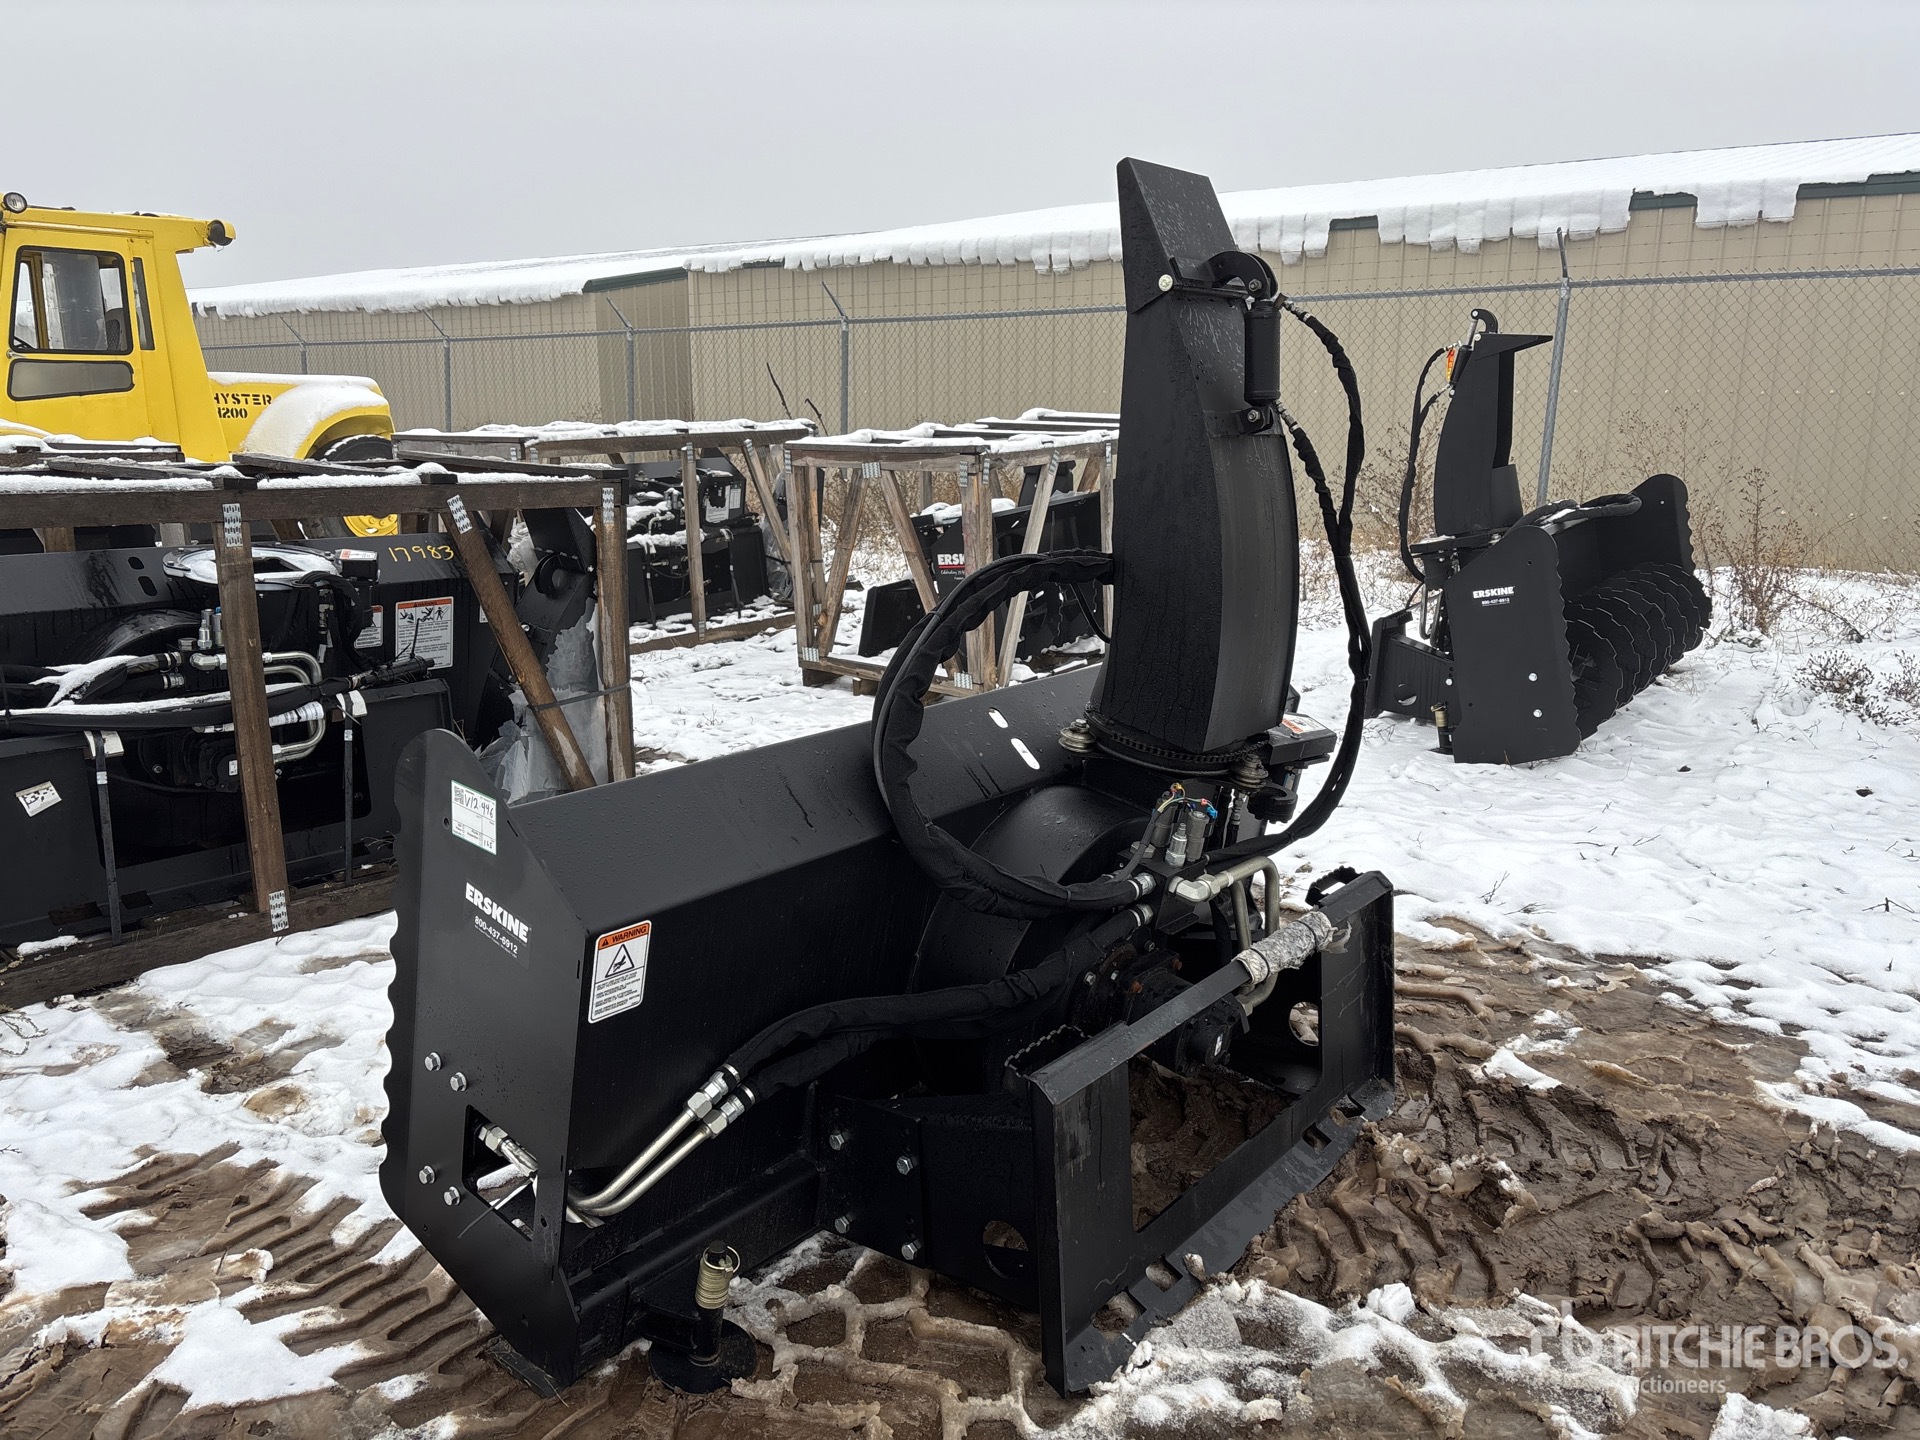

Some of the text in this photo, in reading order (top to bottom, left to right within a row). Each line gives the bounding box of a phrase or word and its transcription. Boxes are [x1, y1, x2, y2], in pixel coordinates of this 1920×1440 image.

[388, 544, 454, 562] 17983
[1472, 586, 1515, 599] ERSKINE
[465, 882, 529, 943] ERSKINE
[612, 926, 647, 943] WARNING
